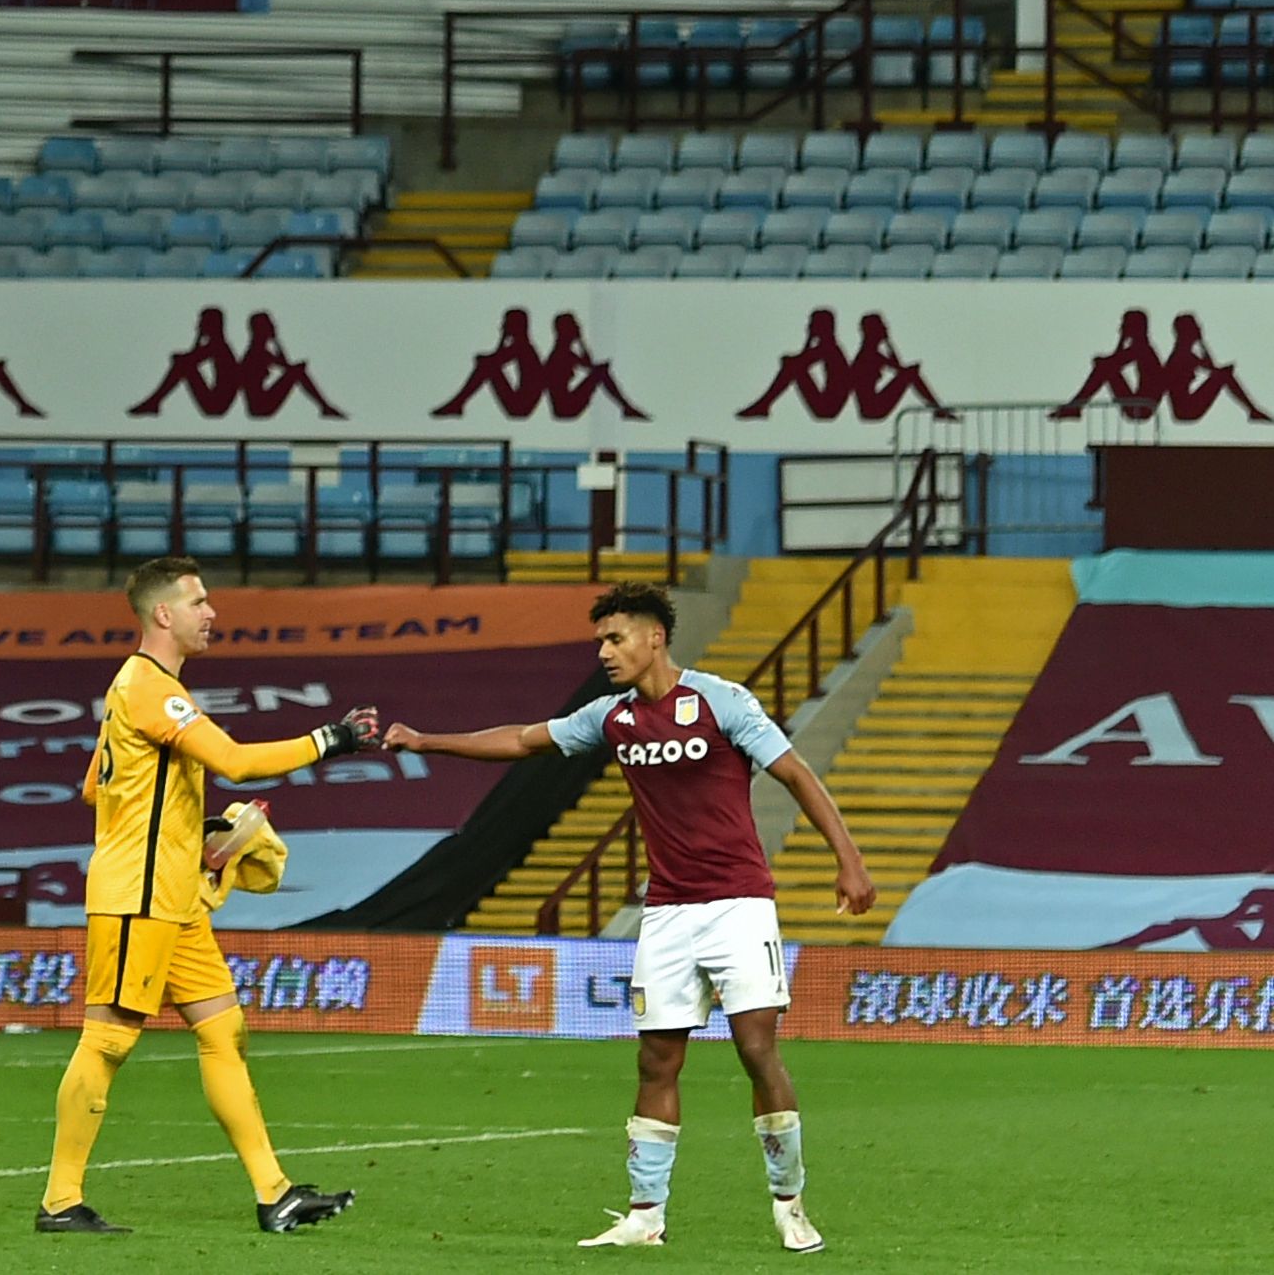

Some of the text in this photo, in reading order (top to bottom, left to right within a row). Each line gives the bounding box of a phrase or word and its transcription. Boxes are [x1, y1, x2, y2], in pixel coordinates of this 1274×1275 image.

[59, 629, 136, 646] AR
[320, 615, 483, 643] TEAM
[616, 736, 709, 766] CAZOO
[587, 976, 633, 1008] LT
